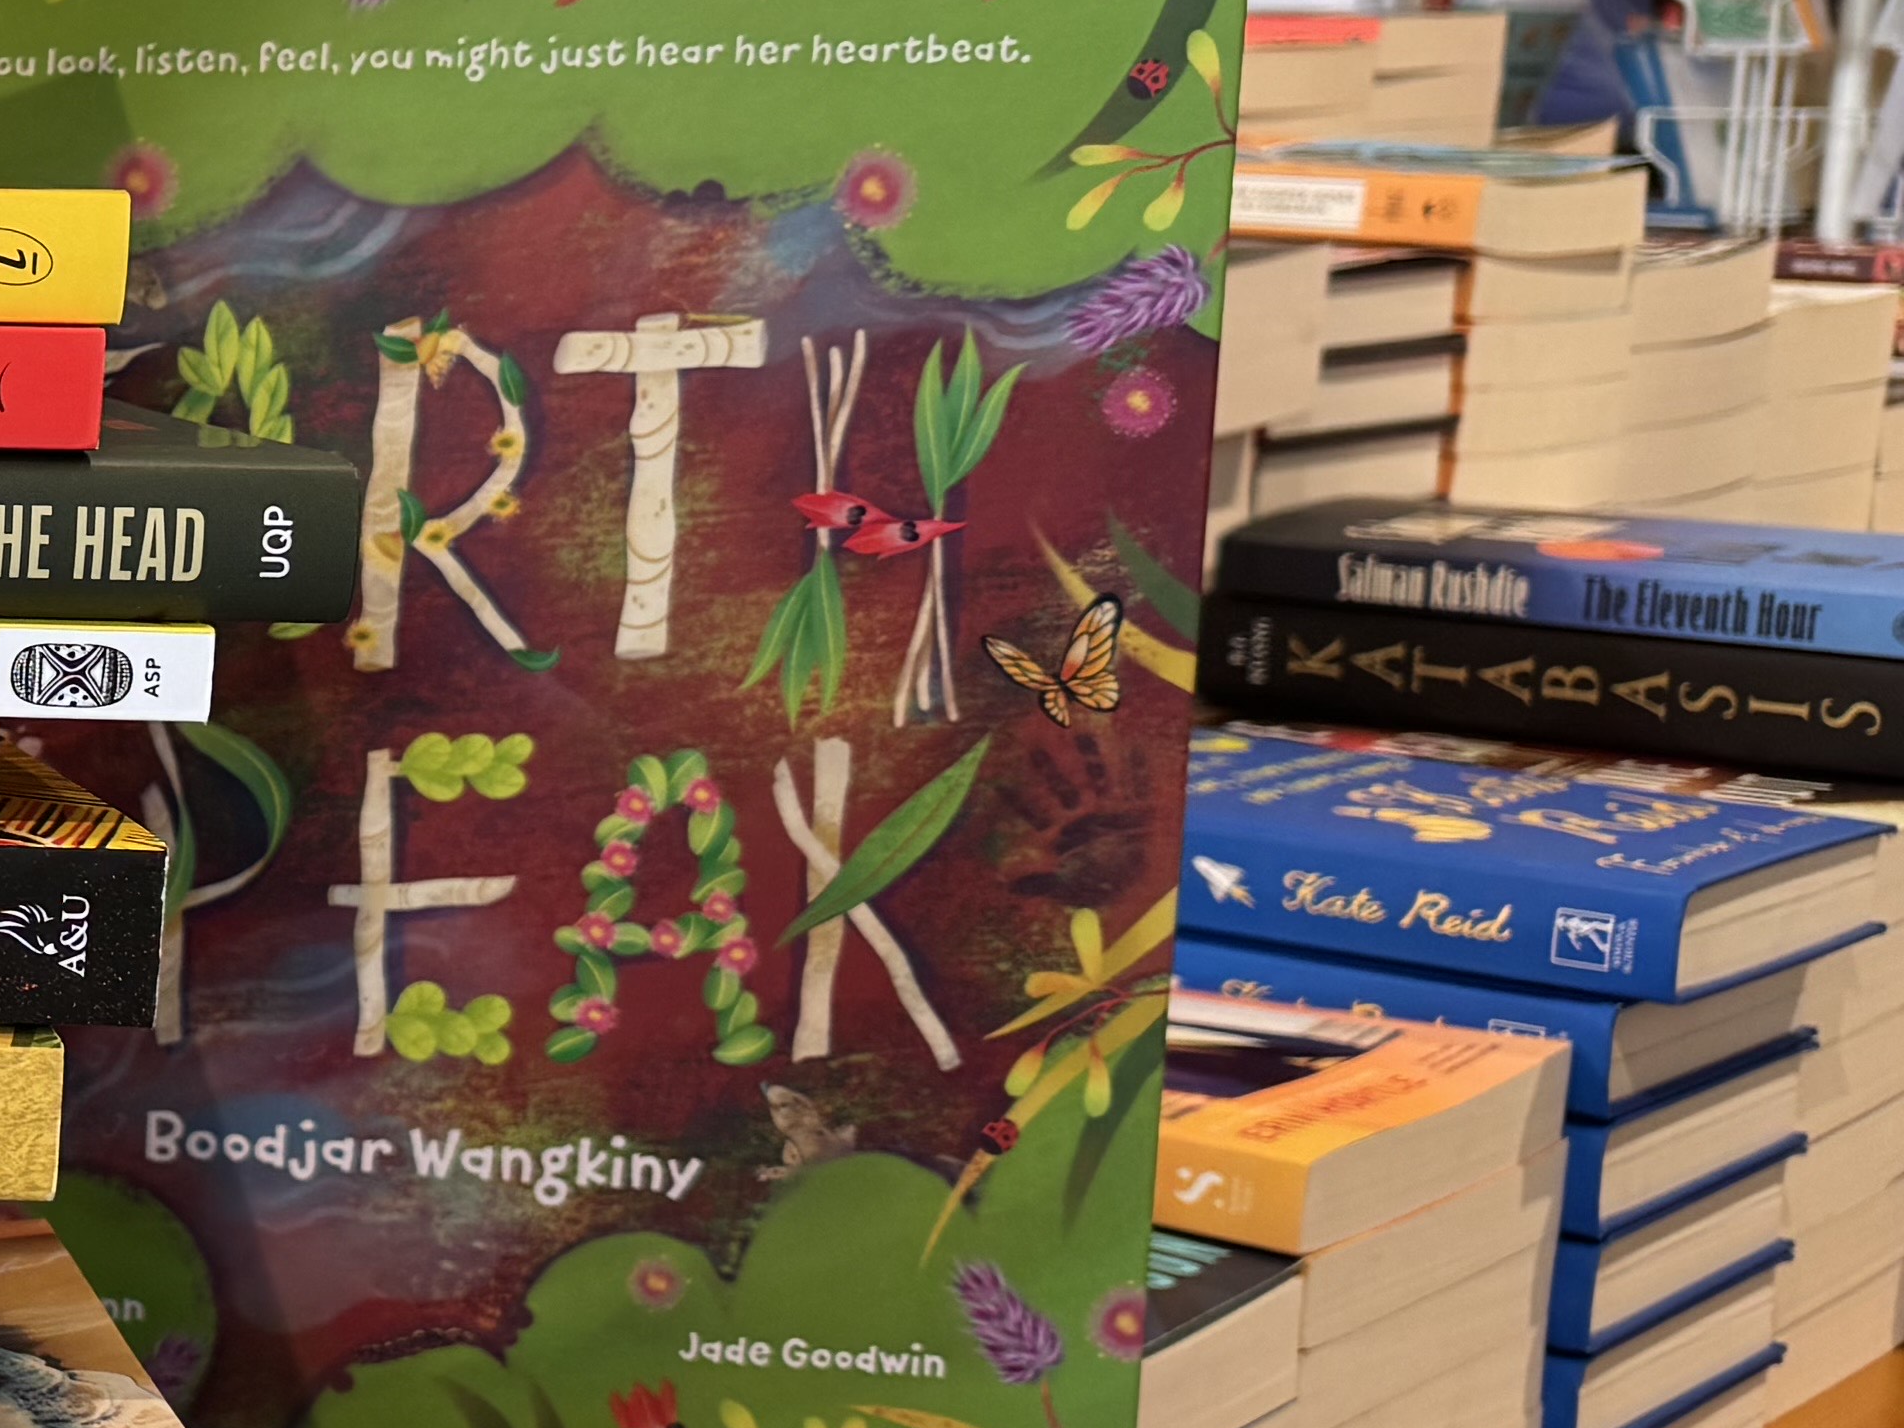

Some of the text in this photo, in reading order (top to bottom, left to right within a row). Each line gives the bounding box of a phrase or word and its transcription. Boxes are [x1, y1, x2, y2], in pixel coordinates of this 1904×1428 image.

[47, 44, 126, 76] look,
[137, 40, 250, 78] listen,
[258, 38, 339, 77] feel,
[349, 43, 414, 80] you
[426, 38, 533, 82] might
[541, 34, 628, 78] just
[637, 32, 725, 70] hear
[735, 32, 800, 68] her
[810, 30, 1033, 70] heartbeat.
[69, 504, 203, 583] HEAD
[260, 502, 292, 578] UQP
[1336, 552, 1825, 642] Salman Rushdie The Eleventh Hour
[1282, 871, 1512, 944] Kate Reid
[145, 1111, 705, 1206] Boodjar Wangkiny
[679, 1331, 945, 1381] Jade Goodwin
